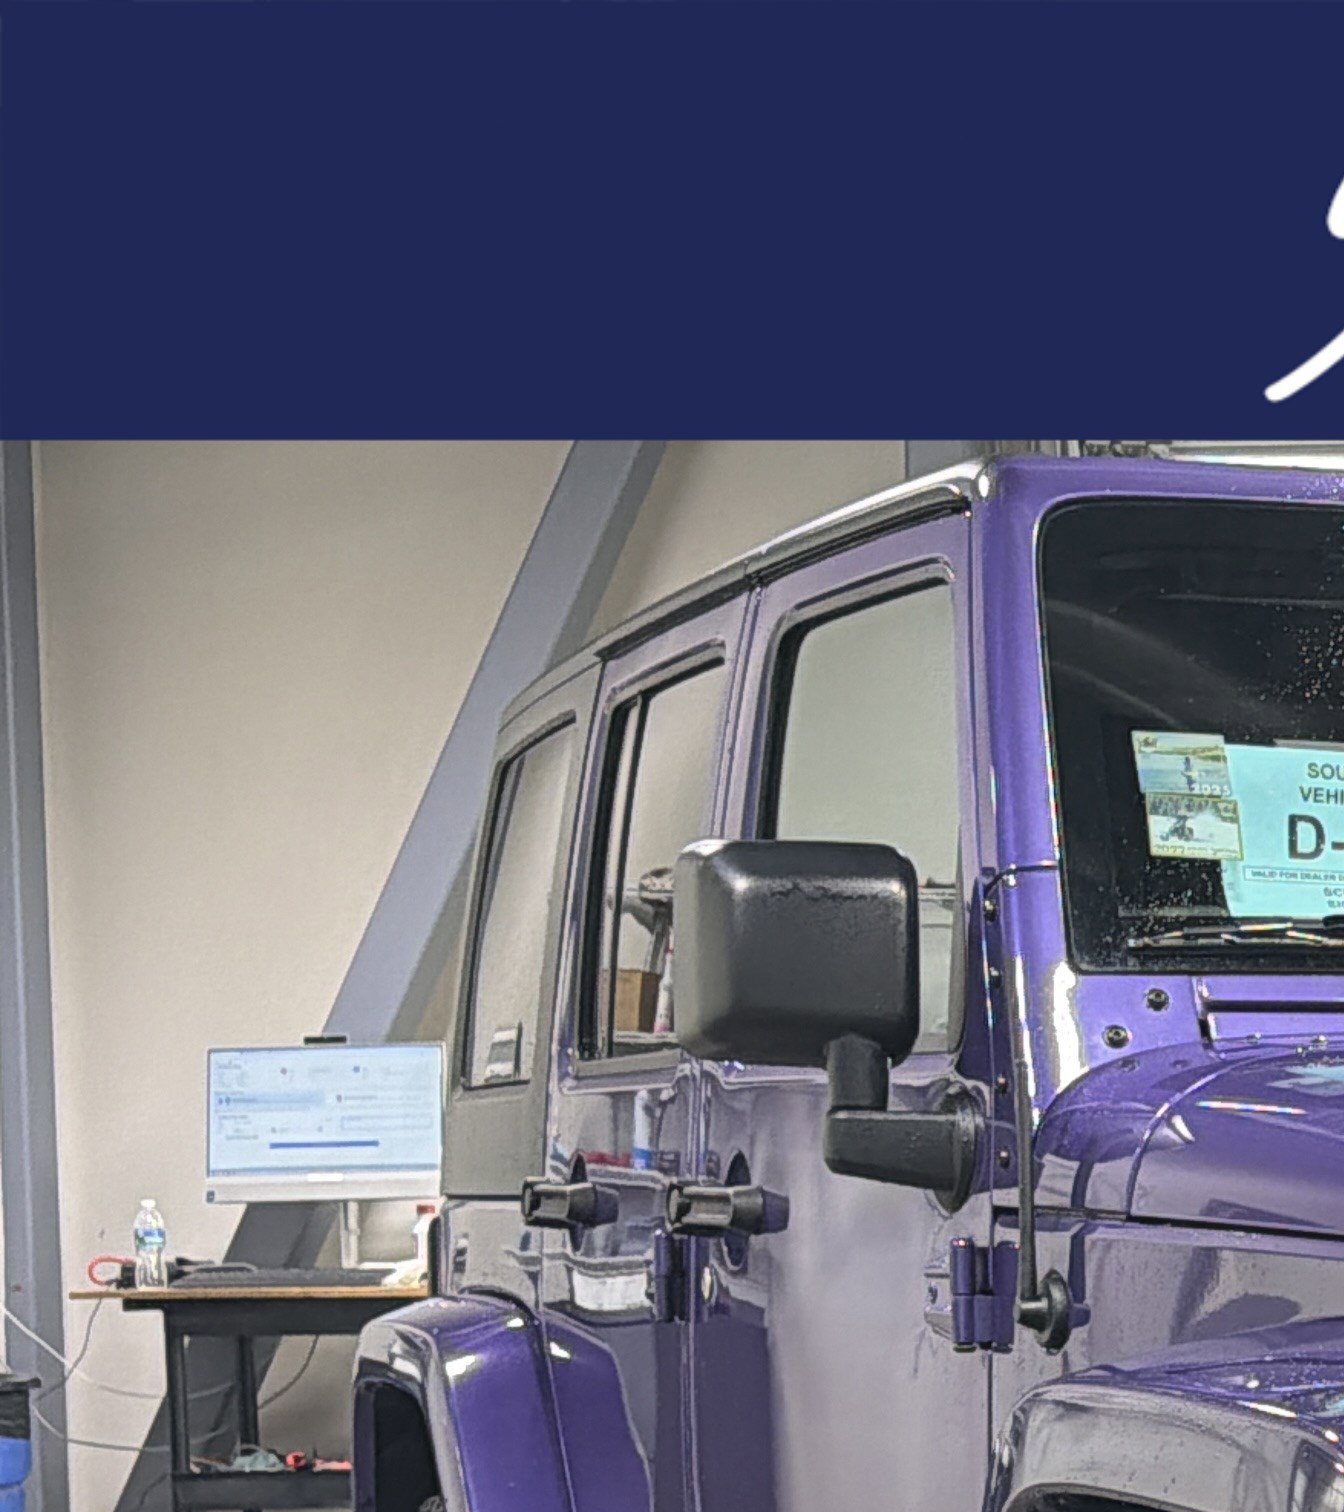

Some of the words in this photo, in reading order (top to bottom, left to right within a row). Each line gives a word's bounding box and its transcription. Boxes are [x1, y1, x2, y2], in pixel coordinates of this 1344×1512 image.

[1250, 869, 1277, 879] VALID
[1279, 871, 1297, 880] FOR
[1301, 872, 1337, 882] DEALER
